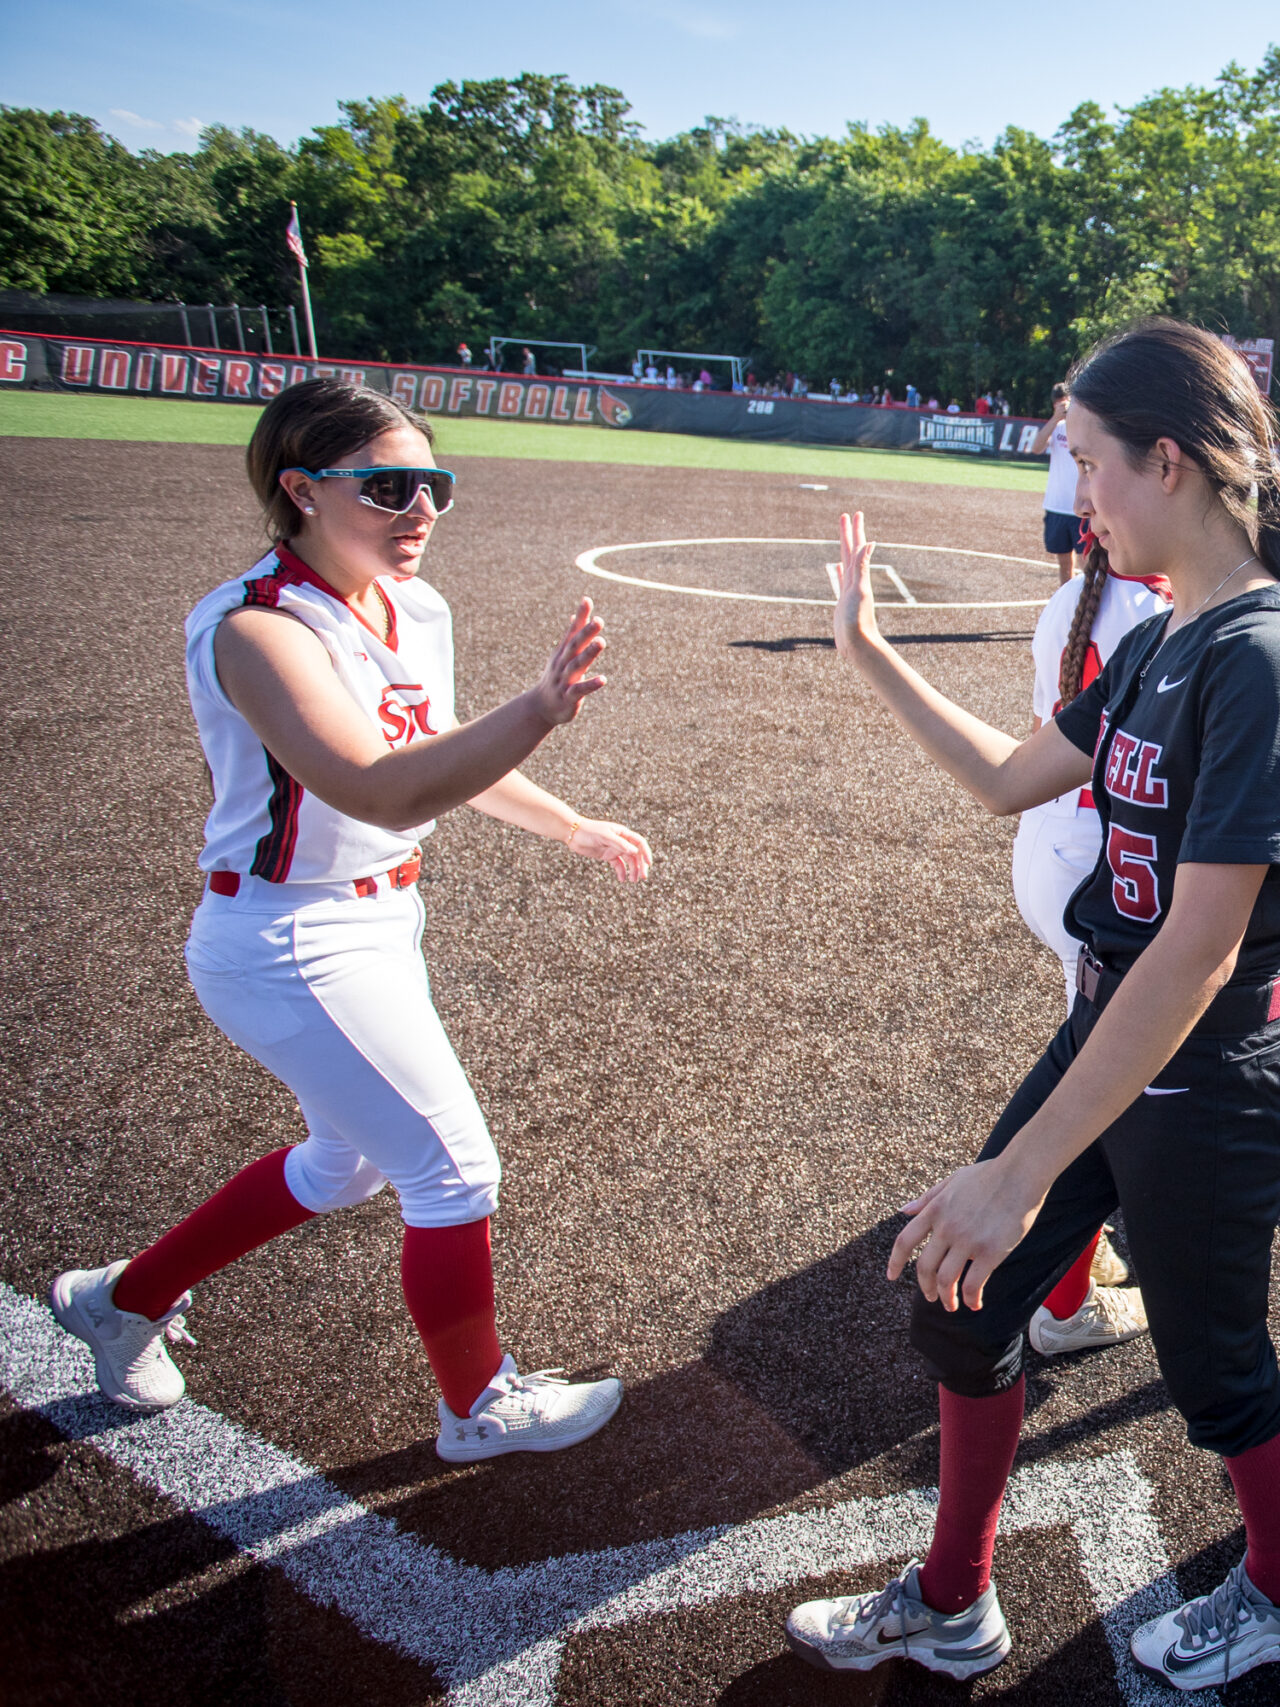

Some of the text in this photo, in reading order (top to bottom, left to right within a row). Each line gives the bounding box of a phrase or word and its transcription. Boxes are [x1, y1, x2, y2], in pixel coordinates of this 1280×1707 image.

[391, 373, 593, 421] SOFTBALL
[919, 419, 994, 447] LANDMARK
[1106, 822, 1161, 923] 5
